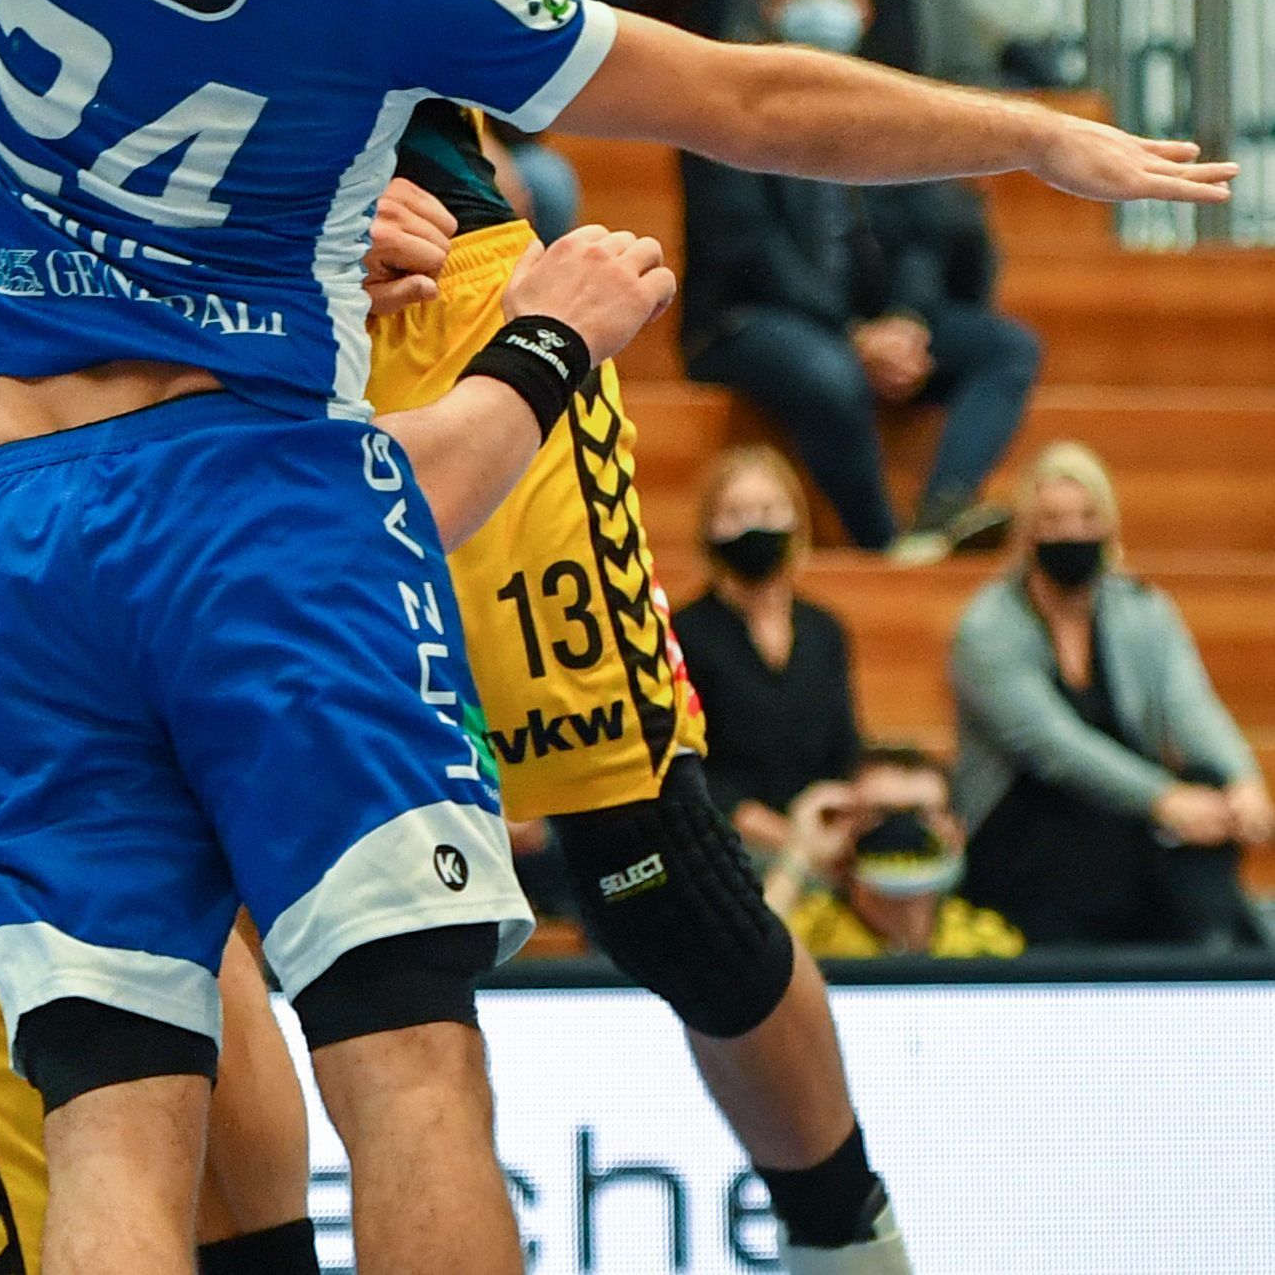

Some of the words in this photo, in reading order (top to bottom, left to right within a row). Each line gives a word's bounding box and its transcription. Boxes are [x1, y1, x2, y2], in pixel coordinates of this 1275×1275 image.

[497, 559, 605, 680] 13
[490, 698, 624, 765] vkw
[599, 852, 665, 897] SELECT
